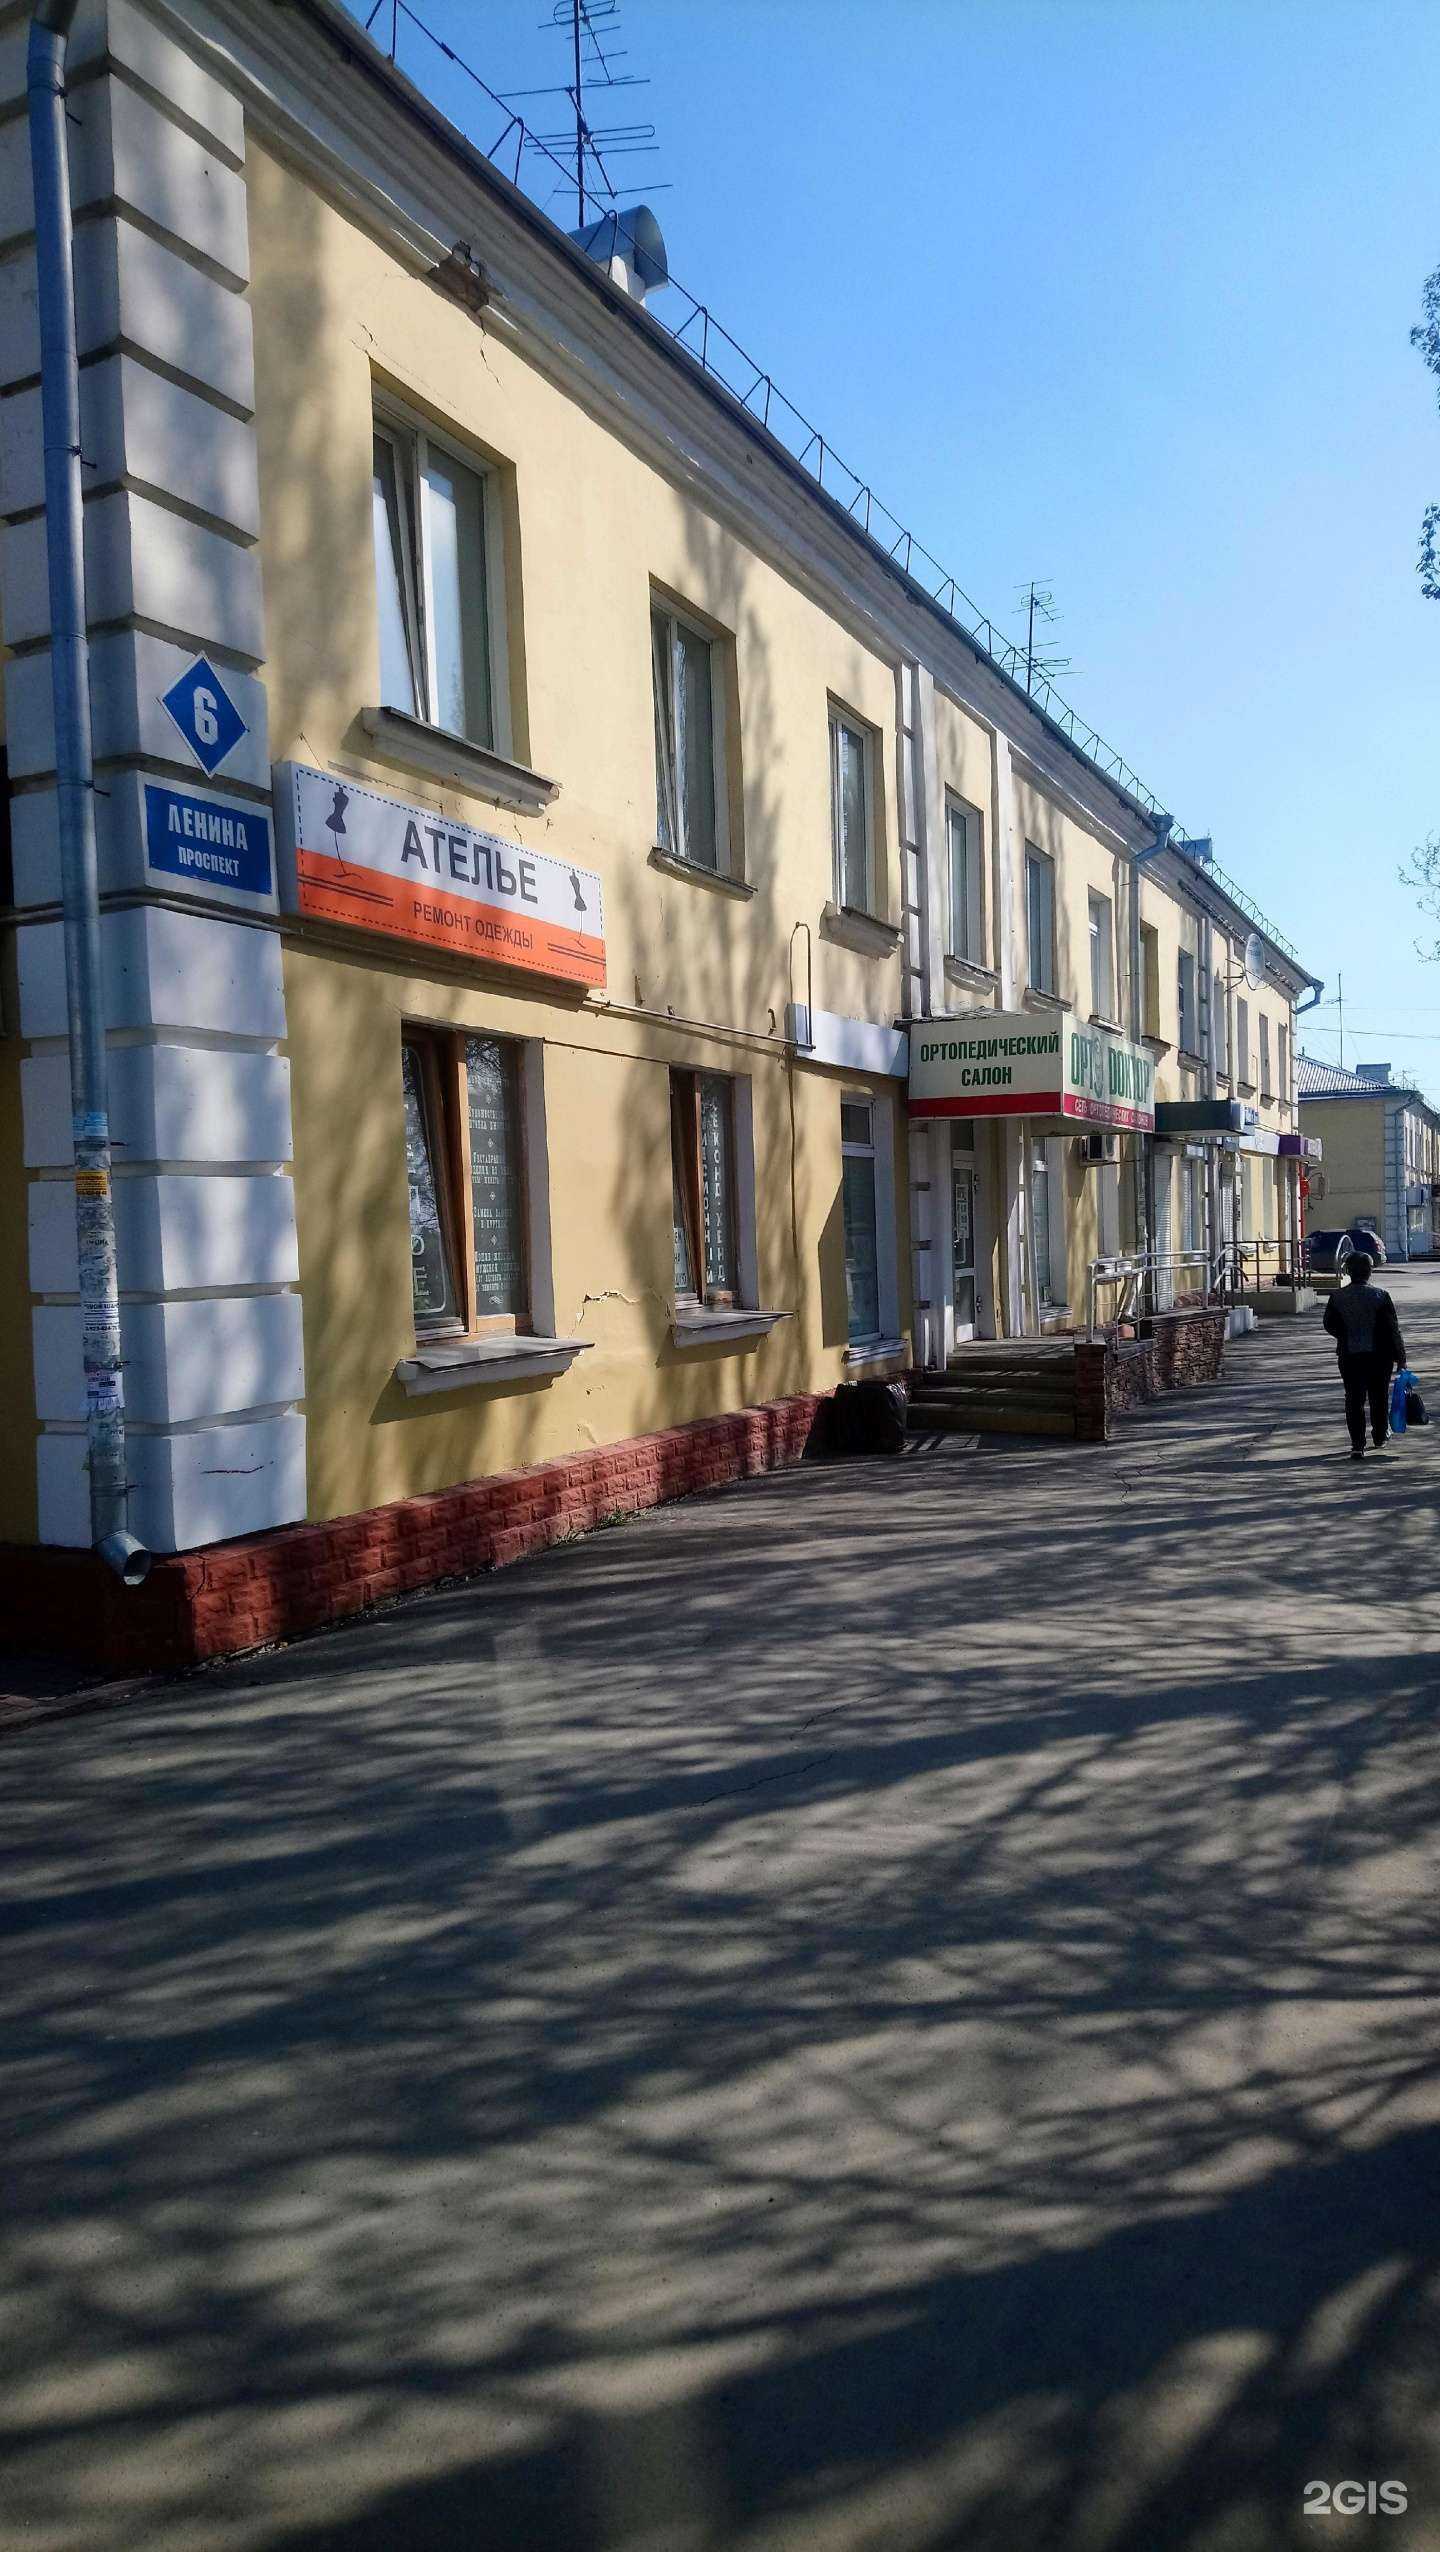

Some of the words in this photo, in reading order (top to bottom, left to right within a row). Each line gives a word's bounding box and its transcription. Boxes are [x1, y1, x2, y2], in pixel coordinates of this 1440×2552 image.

[193, 686, 219, 745] 6
[168, 804, 249, 852] ЛЕНИНА
[178, 845, 240, 878] ПРОСПЕКТ
[401, 820, 539, 904] АТЕЛЬЕ
[413, 900, 472, 934] РЕМОНТ
[474, 916, 534, 951] ОДЕЖДЫ
[920, 1031, 1059, 1062] ОРТОПЕДИЧЕСКИЙ
[961, 1066, 1012, 1087] САЛОН
